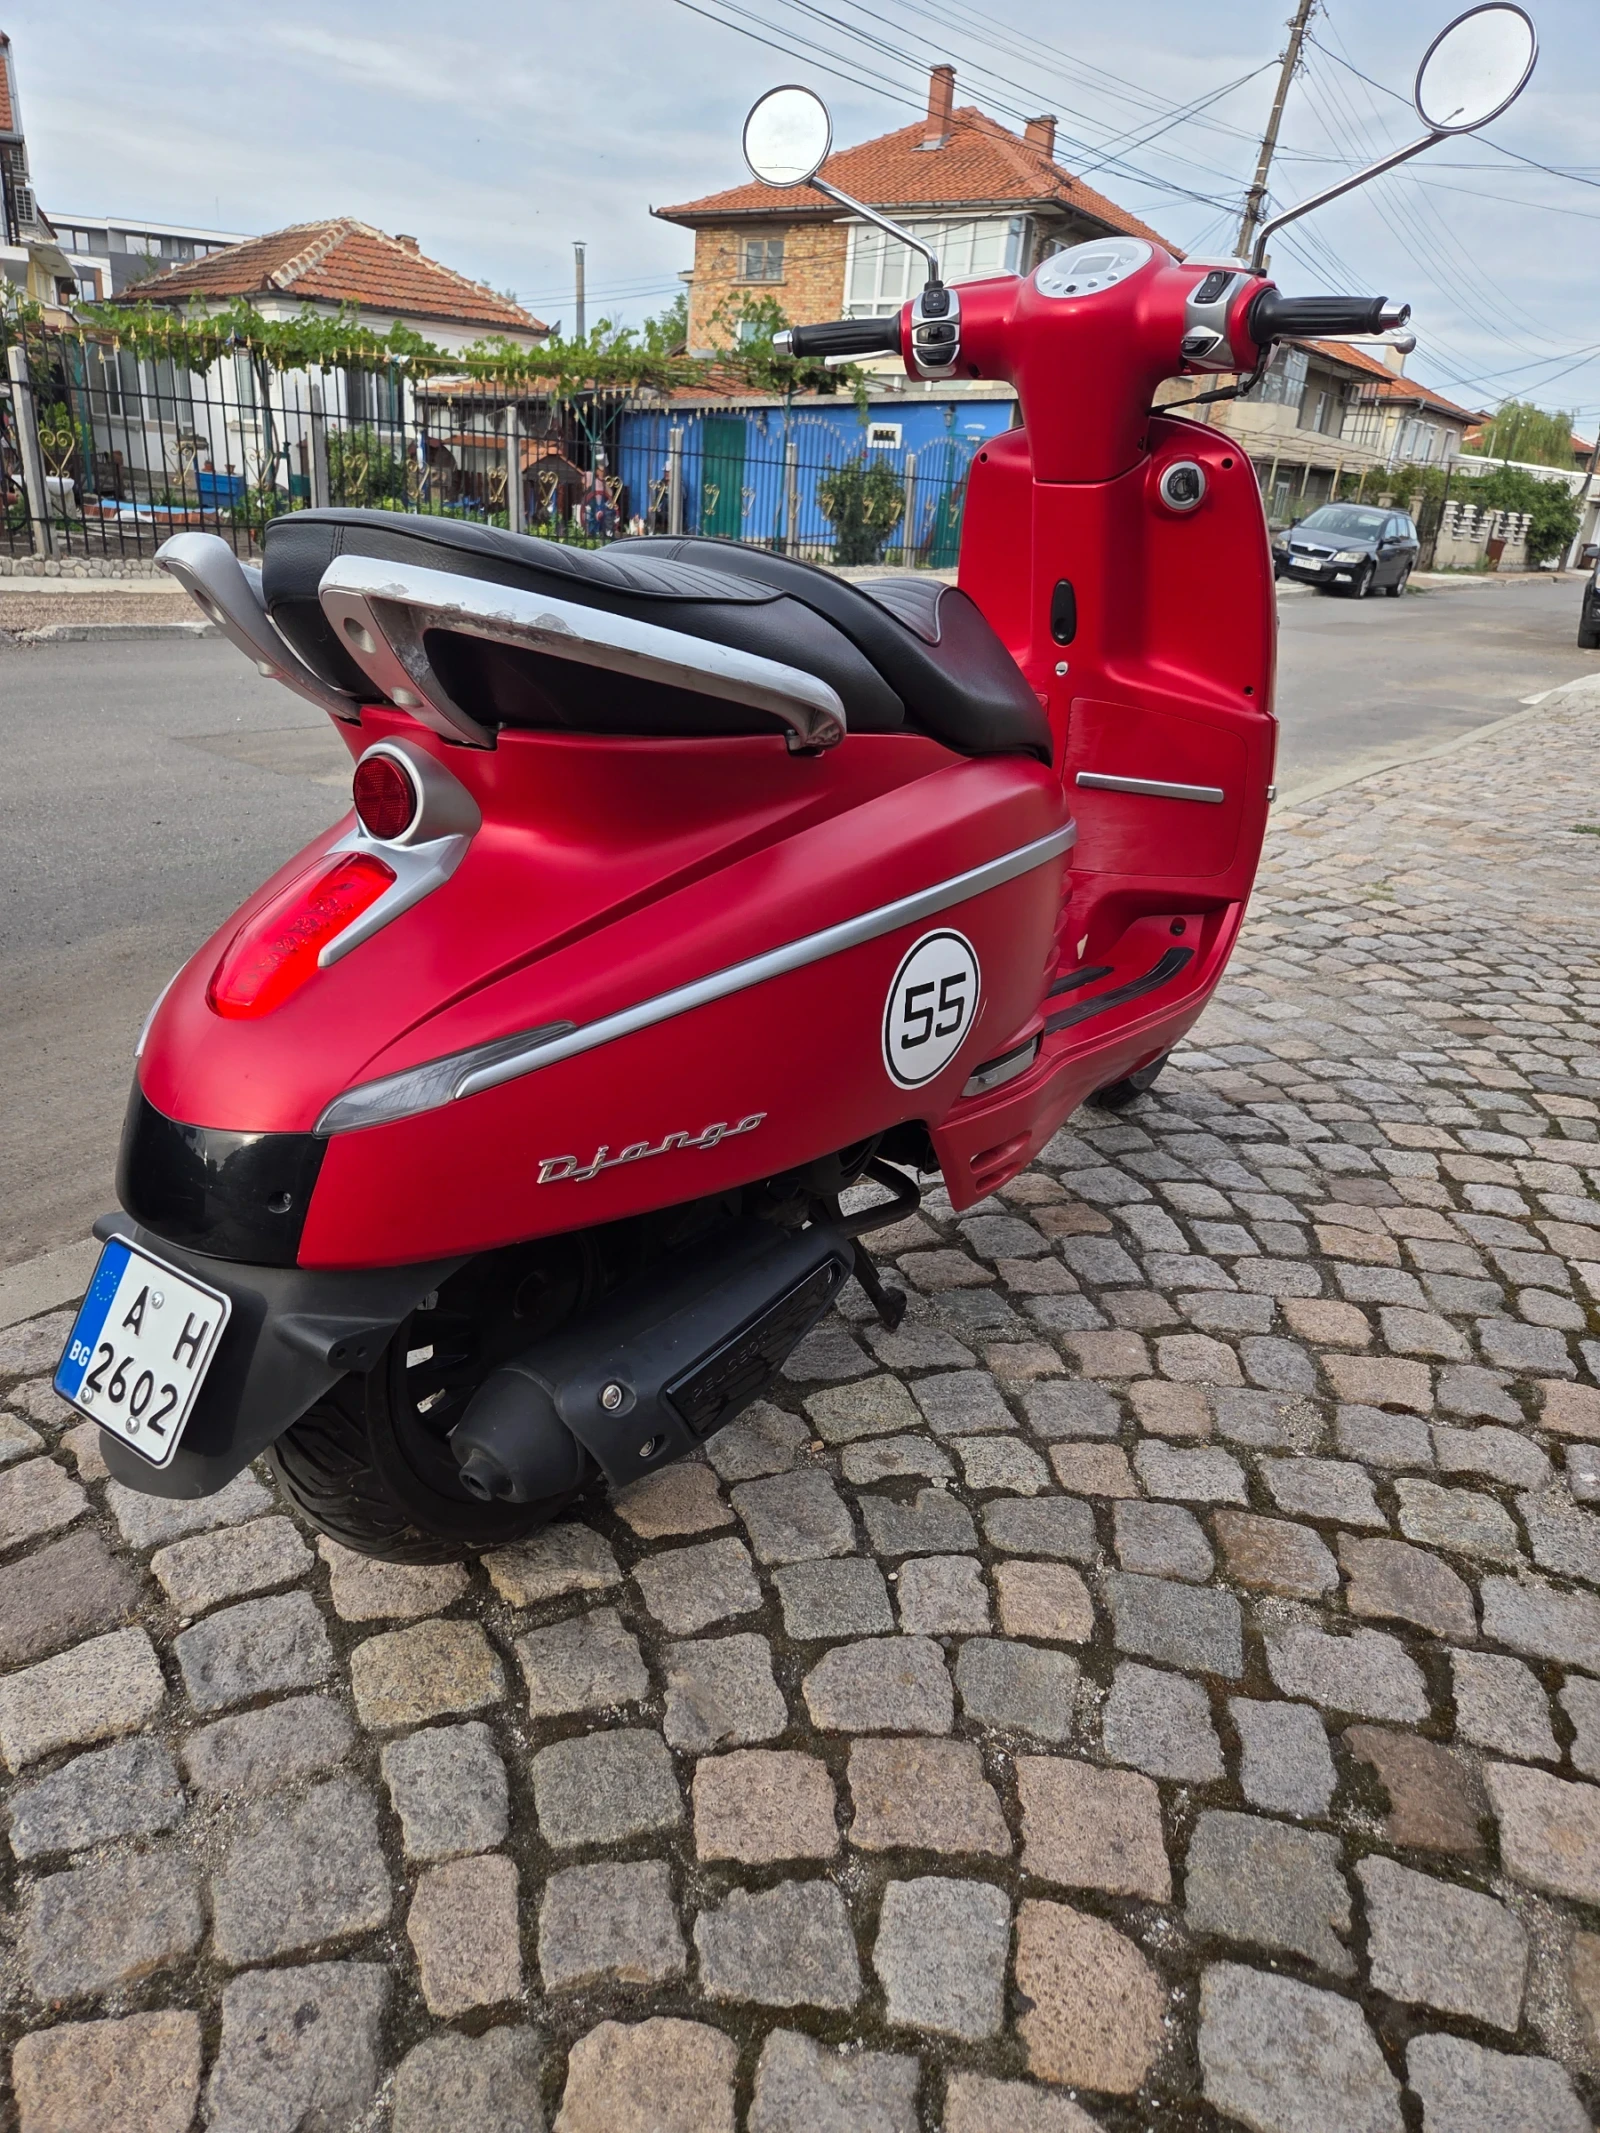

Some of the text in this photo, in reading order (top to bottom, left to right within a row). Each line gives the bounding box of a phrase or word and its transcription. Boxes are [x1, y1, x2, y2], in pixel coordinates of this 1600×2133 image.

[901, 971, 966, 1050] 55
[537, 1112, 767, 1184] Django
[69, 1339, 91, 1367] BG
[122, 1285, 210, 1369] A H
[86, 1342, 179, 1437] 2602
